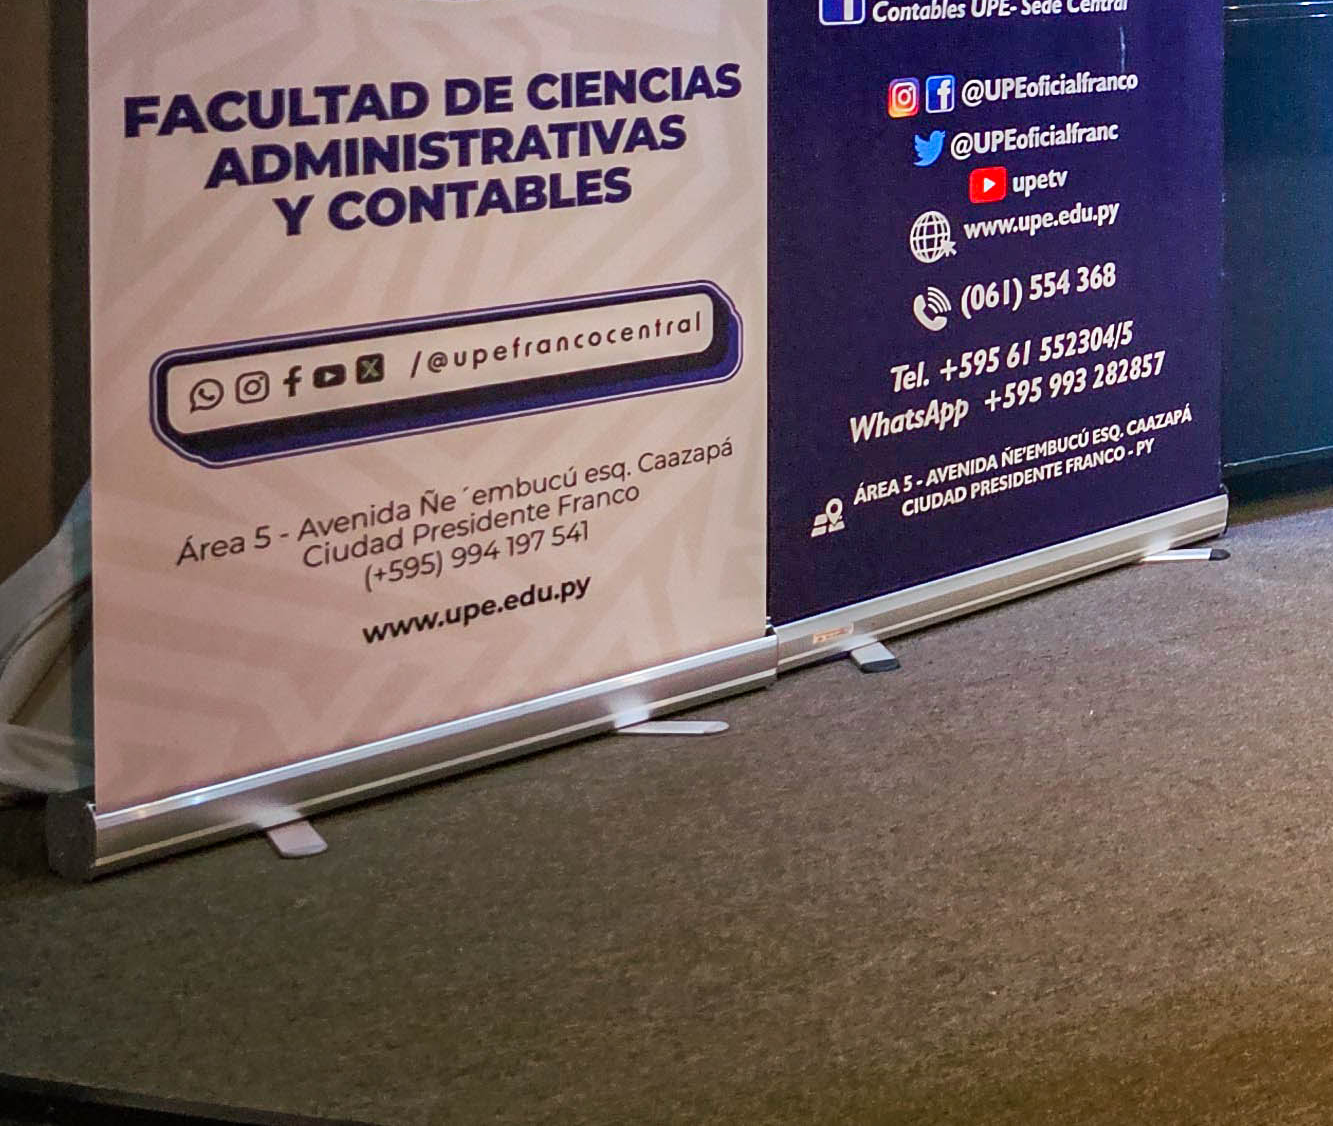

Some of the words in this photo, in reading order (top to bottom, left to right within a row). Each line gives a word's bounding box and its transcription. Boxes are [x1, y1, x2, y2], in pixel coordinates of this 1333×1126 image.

[123, 81, 429, 138] FACULTAD
[445, 75, 513, 117] DE
[527, 63, 743, 111] CIENCIAS
[961, 72, 1139, 107] @UPEoficialfranco
[204, 114, 687, 189] ADMINISTRATIVAS
[950, 122, 1119, 161] @UPEoficialfranc
[273, 195, 314, 237] Y
[327, 167, 632, 231] CONTABLES
[1012, 169, 1068, 197] upetv
[963, 201, 1120, 241] www.upe.edu.py
[961, 277, 1022, 320] (061)
[1029, 269, 1070, 301] 554
[1076, 261, 1117, 293] 368
[410, 311, 701, 379] /@upefrancocentral
[890, 362, 930, 393] Tel.
[939, 346, 1000, 382] +595
[1006, 339, 1031, 368] 61
[1039, 320, 1134, 363] 552304/5
[849, 397, 969, 444] WhatsApp
[984, 375, 1042, 413] +595
[1049, 367, 1087, 398] 993
[1092, 350, 1166, 390] 282857
[853, 475, 900, 506] ÁREA
[903, 475, 913, 494] 5
[926, 452, 998, 486] AVENIDA
[1092, 424, 1123, 446] ESQ.
[1126, 403, 1193, 438] CAAZAPÁ
[901, 484, 967, 518] CIUDAD
[970, 462, 1063, 500] PRESIDENTE
[1065, 446, 1125, 478] FRANCO
[1136, 437, 1155, 457] PY
[176, 535, 246, 566] Área
[253, 526, 271, 551] 5
[297, 500, 411, 542] Avenida
[584, 459, 632, 487] esq.
[638, 437, 734, 477] Caazapá
[302, 530, 404, 569] Ciudad
[412, 503, 551, 547] Presidente
[557, 484, 641, 519] Franco
[364, 550, 445, 593] (+595)
[450, 540, 500, 570] 994
[506, 530, 545, 559] 197
[550, 521, 590, 548] 541
[362, 576, 592, 646] www.upe.edu.py
